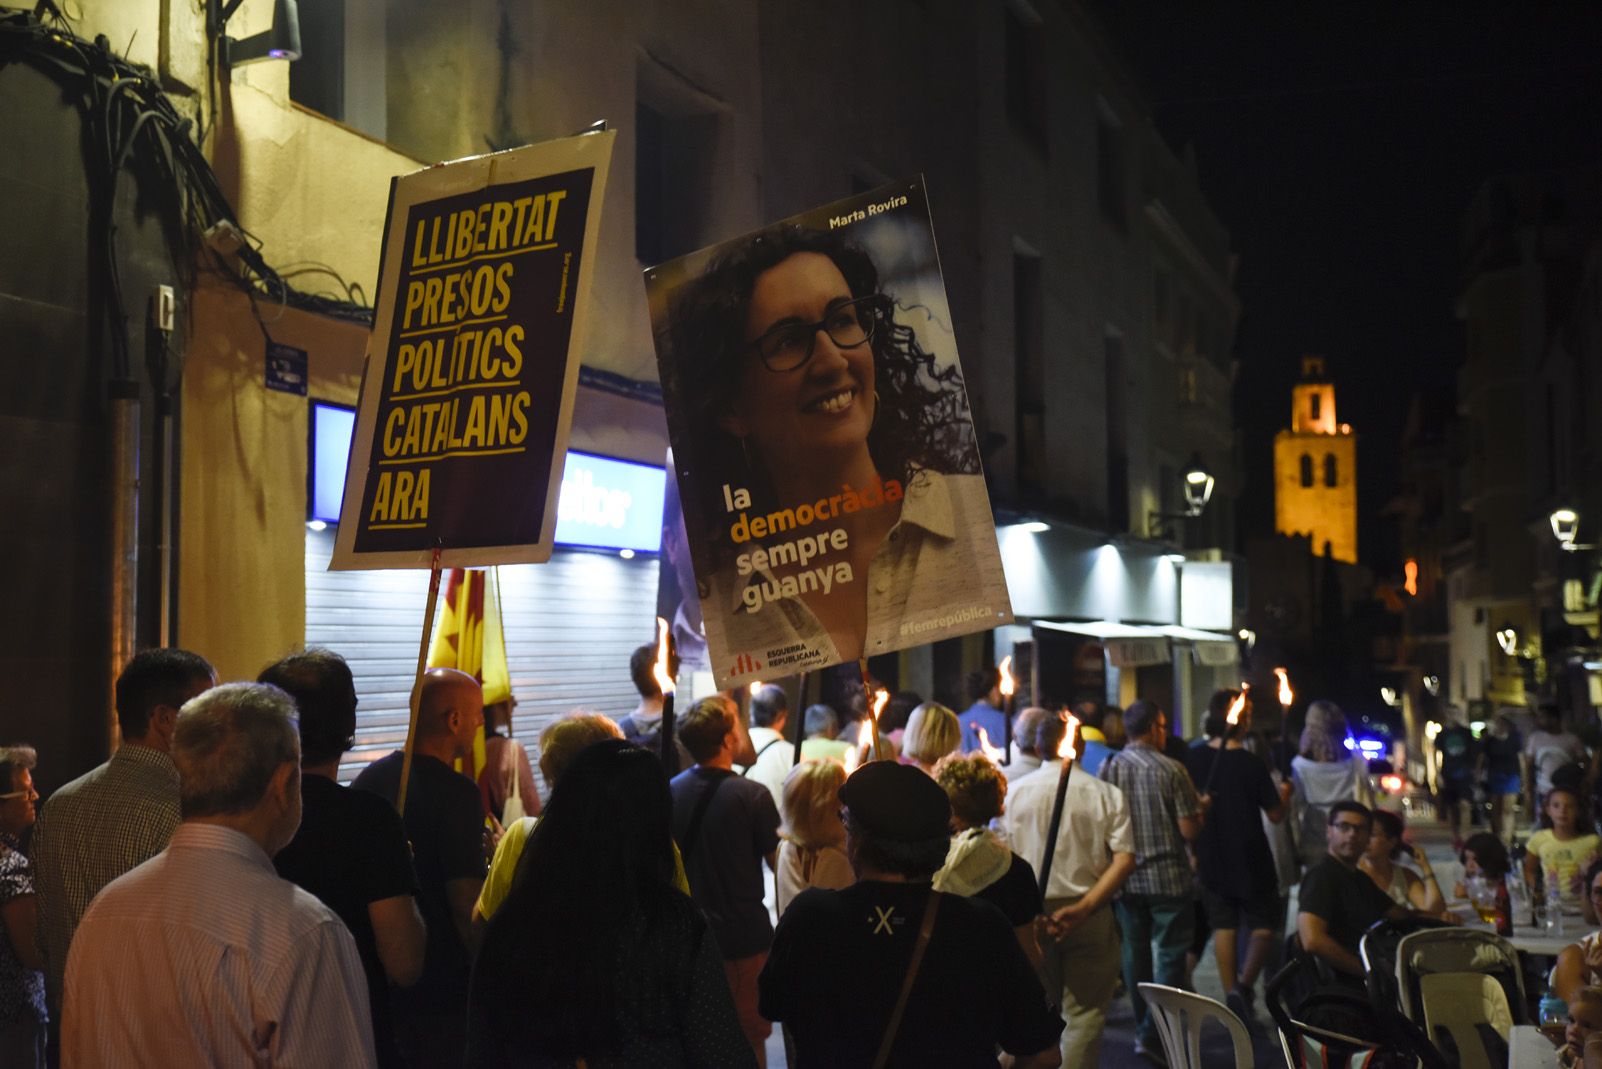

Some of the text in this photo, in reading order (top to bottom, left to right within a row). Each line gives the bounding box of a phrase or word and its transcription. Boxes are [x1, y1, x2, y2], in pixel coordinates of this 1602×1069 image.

[412, 190, 567, 267] LLIBERTAT
[828, 195, 908, 230] Marta Rovira
[403, 262, 514, 329] PRESOS
[393, 325, 525, 392] POLÍTICS
[383, 391, 531, 457] CATALANS
[369, 468, 431, 522] ARA
[722, 482, 752, 513] la
[730, 478, 904, 544] democràcia
[736, 528, 849, 576] sempre
[742, 560, 854, 614] guanya
[900, 606, 993, 636] #femrepública
[767, 643, 806, 659] ESQUERRA
[768, 649, 821, 668] REPUBLICANA
